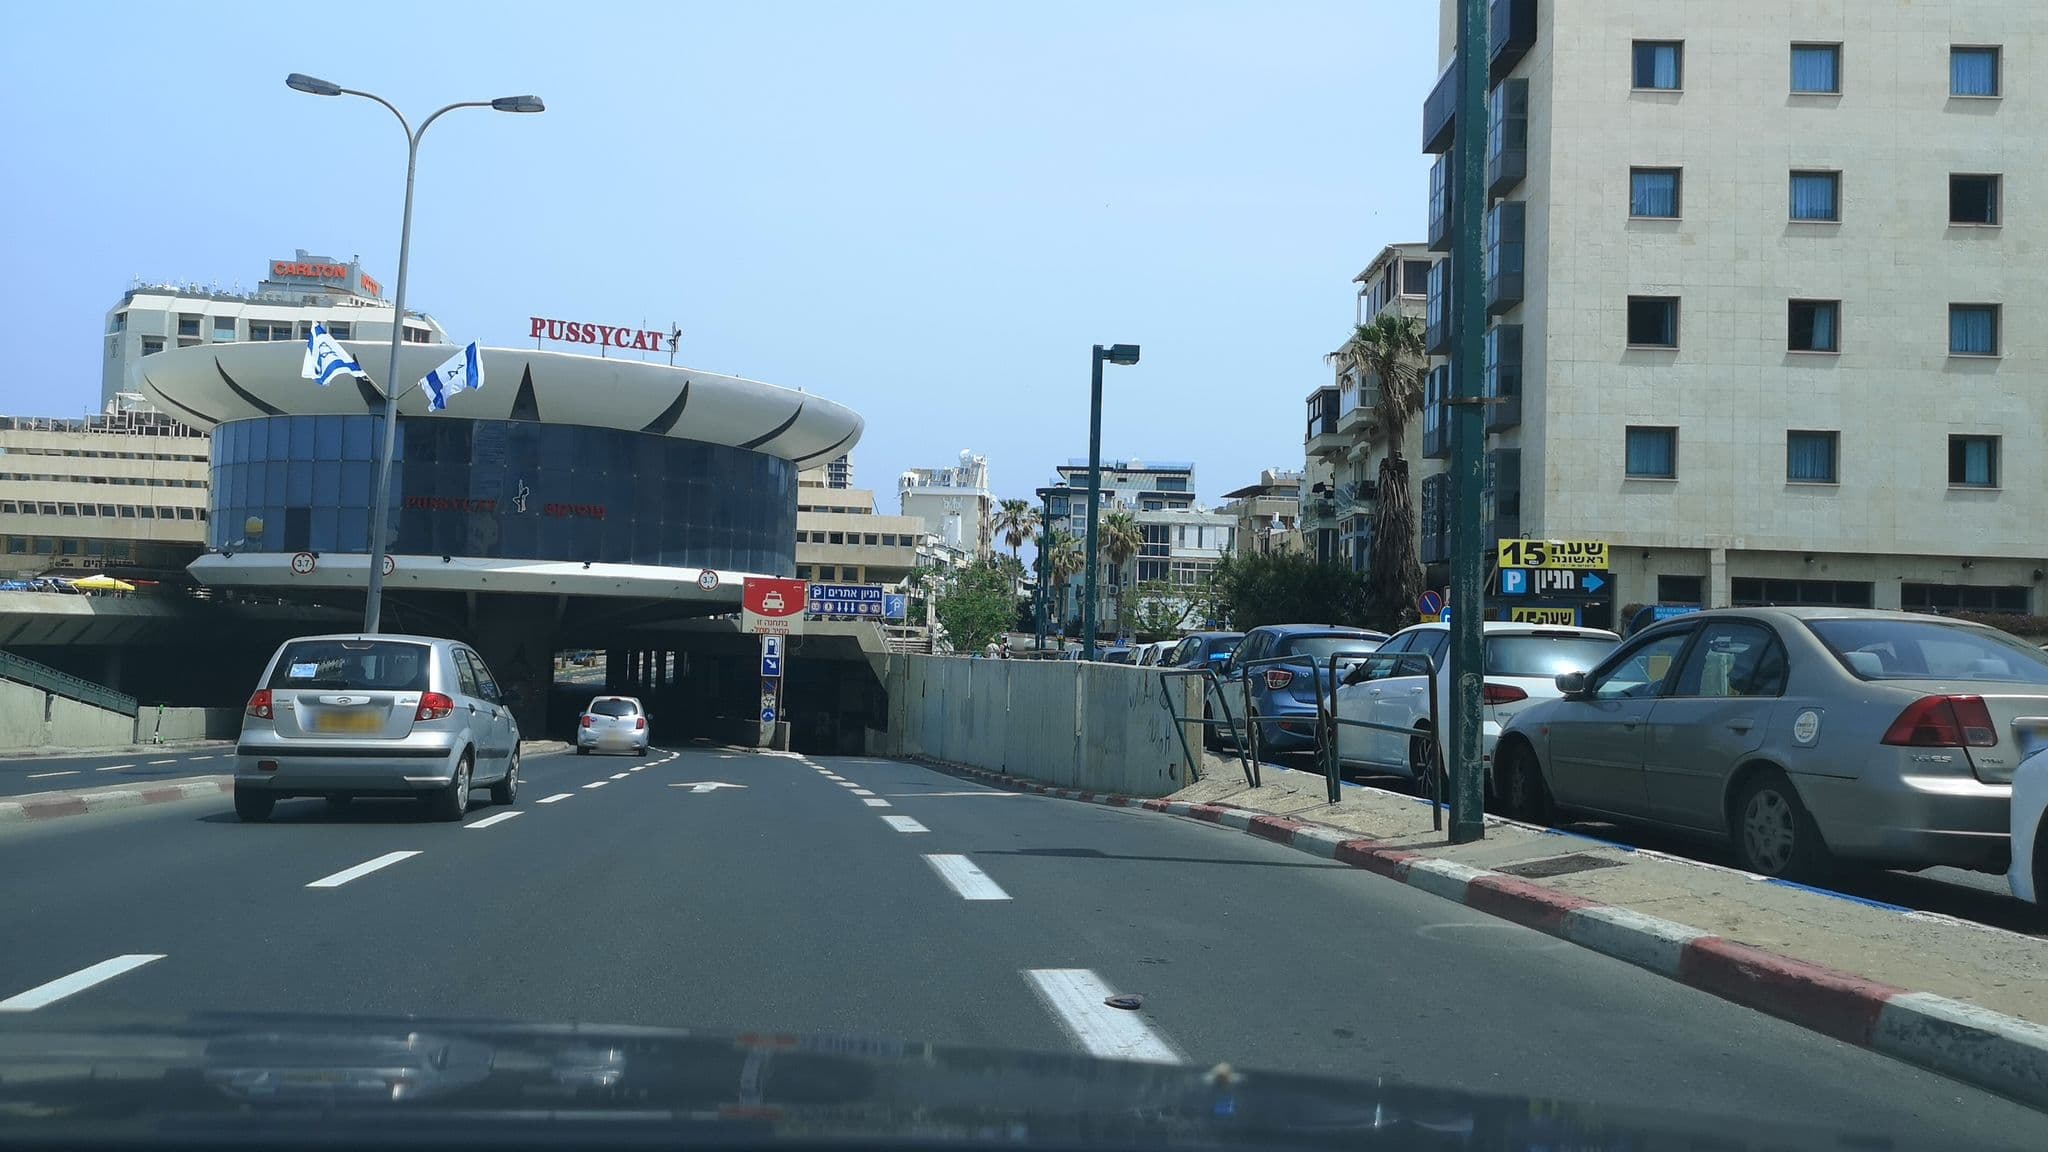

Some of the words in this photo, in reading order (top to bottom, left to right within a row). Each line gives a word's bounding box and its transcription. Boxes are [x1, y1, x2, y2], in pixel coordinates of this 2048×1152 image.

[274, 262, 347, 279] CARLTON
[529, 317, 663, 351] PUSSYCAT
[1503, 542, 1546, 566] 15
[1551, 543, 1603, 555] שעה
[1552, 556, 1604, 564] ראשונה
[1535, 570, 1575, 594] חניון
[828, 588, 857, 598] אתרים
[861, 589, 880, 600] חניון
[1540, 612, 1571, 625] שעה
